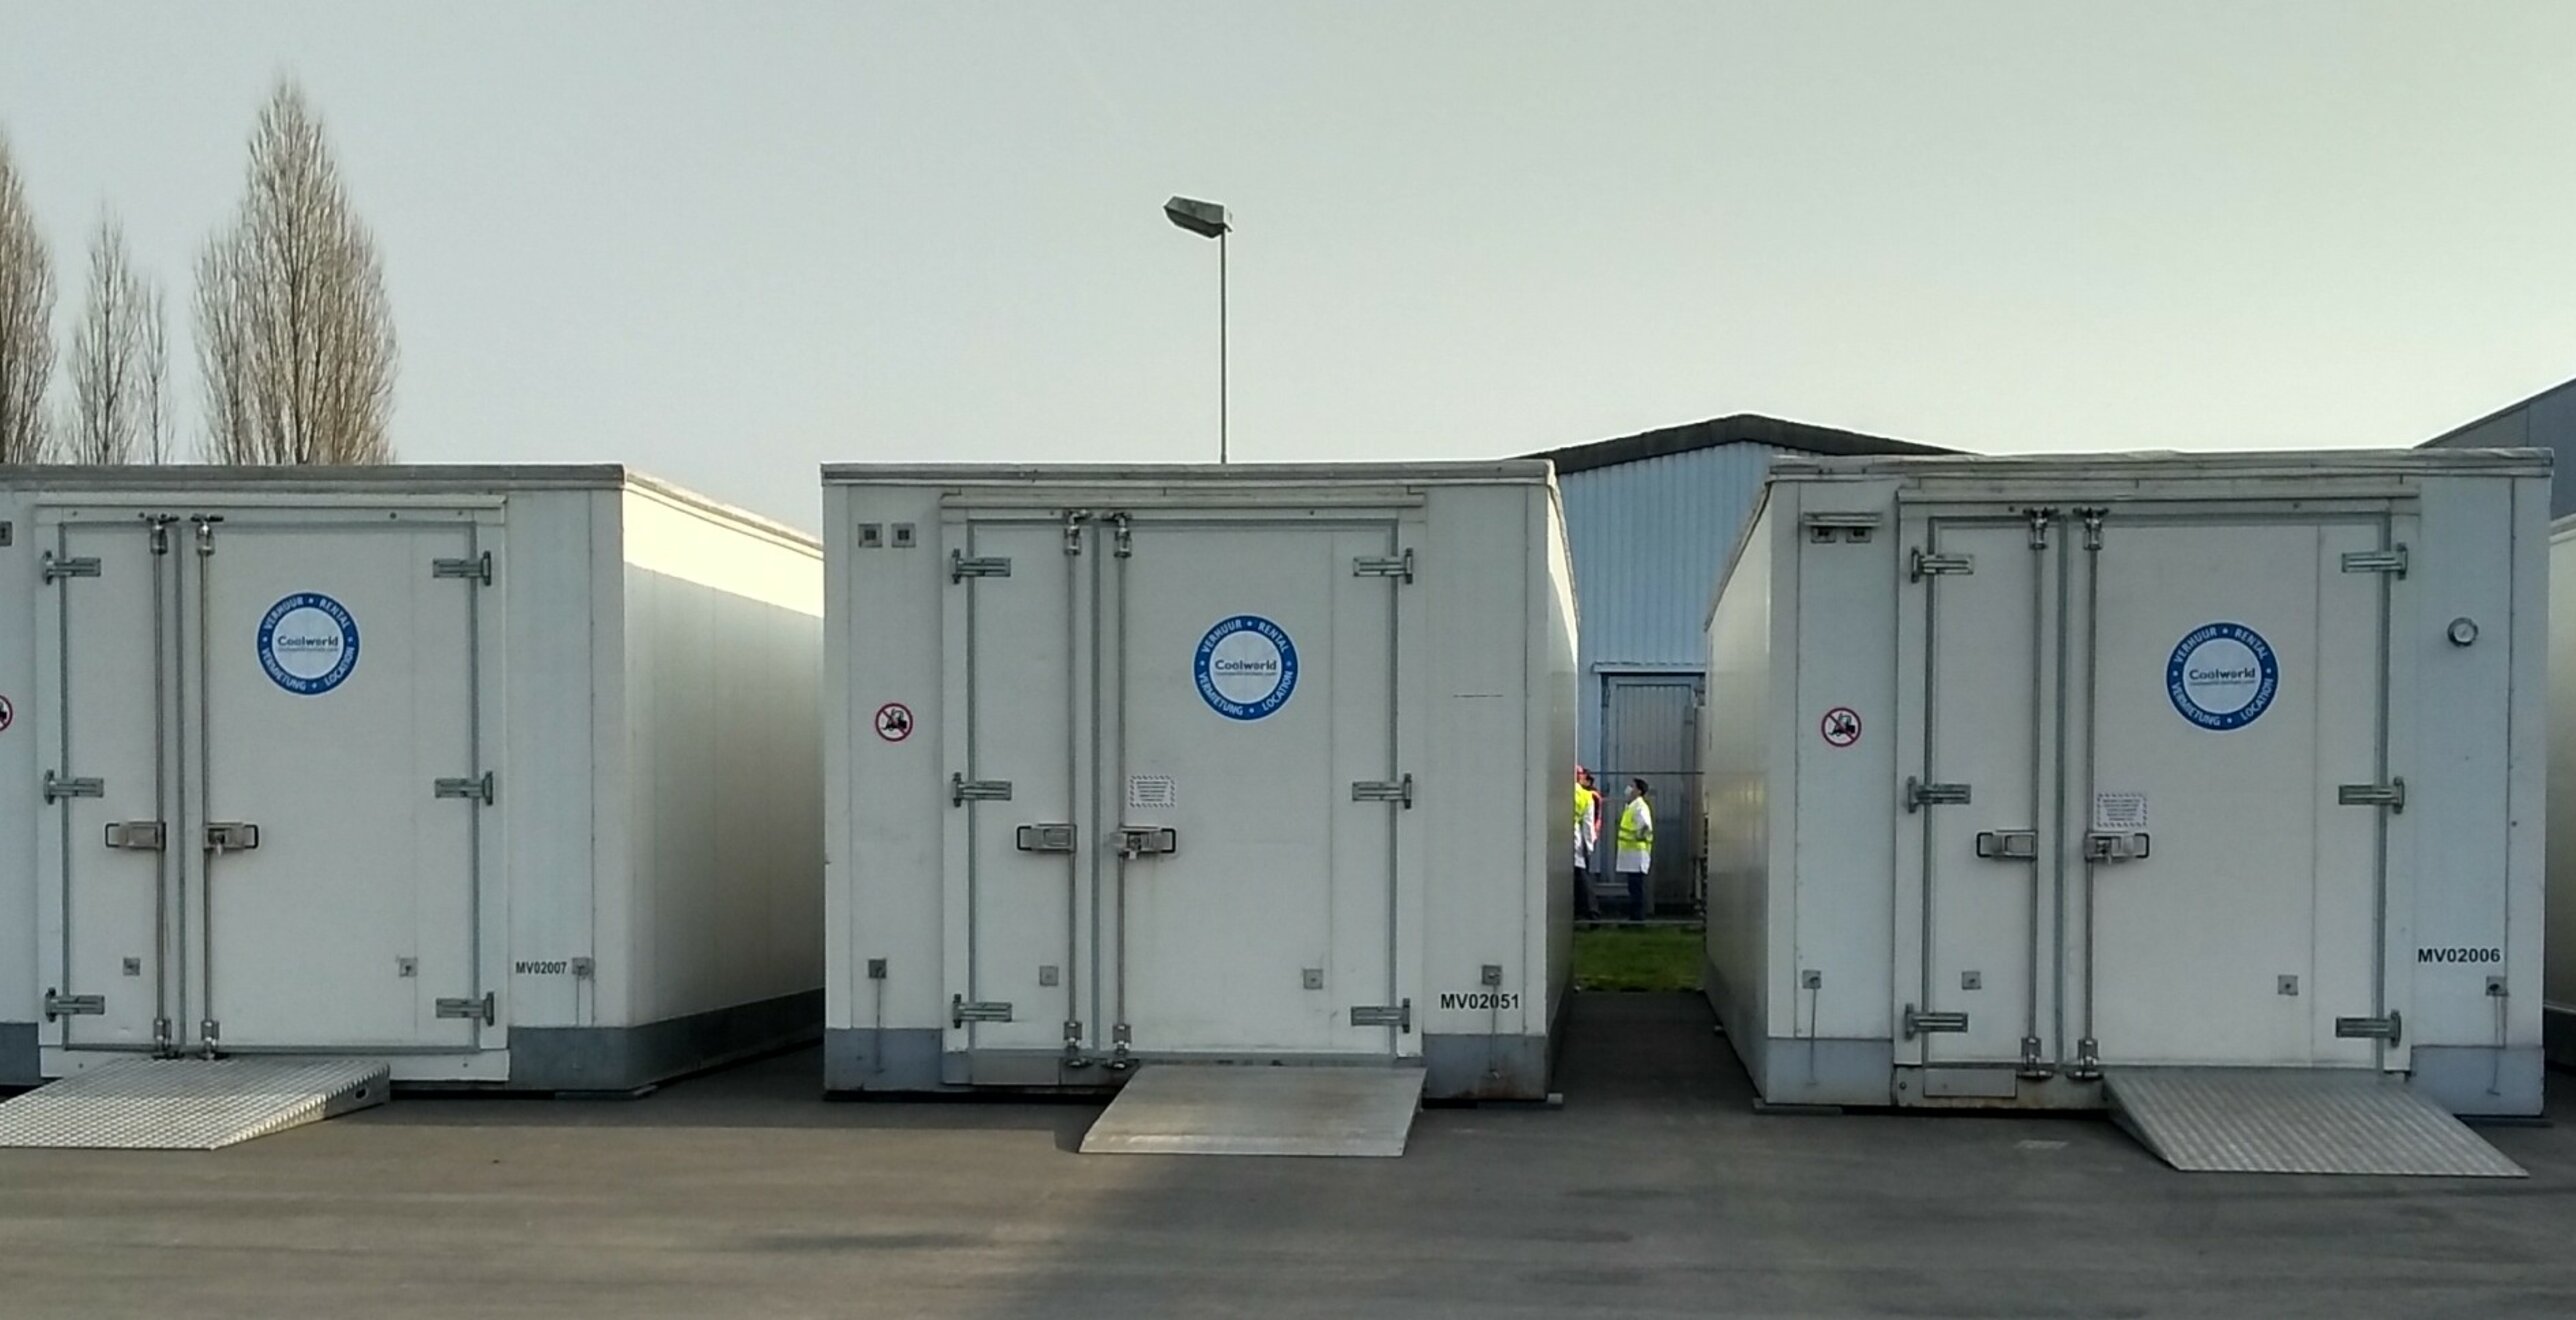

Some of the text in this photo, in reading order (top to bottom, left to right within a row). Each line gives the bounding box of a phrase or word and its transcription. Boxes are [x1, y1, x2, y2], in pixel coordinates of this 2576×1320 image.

[319, 598, 351, 629] RENTAL
[277, 635, 339, 646] Coolworld
[1201, 619, 1289, 653] VERHUUR RENTAL
[2173, 627, 2269, 663] VERHUUR RENTAL
[324, 646, 355, 686] LOCATION
[1215, 659, 1277, 671] Coolworld
[2189, 667, 2256, 680] Coolworld
[1261, 671, 1294, 711] LOCATION
[2239, 678, 2273, 721] LOCATION
[2418, 948, 2501, 963] MV02006
[515, 961, 567, 974] MV02007
[1441, 993, 1519, 1009] MV02051
